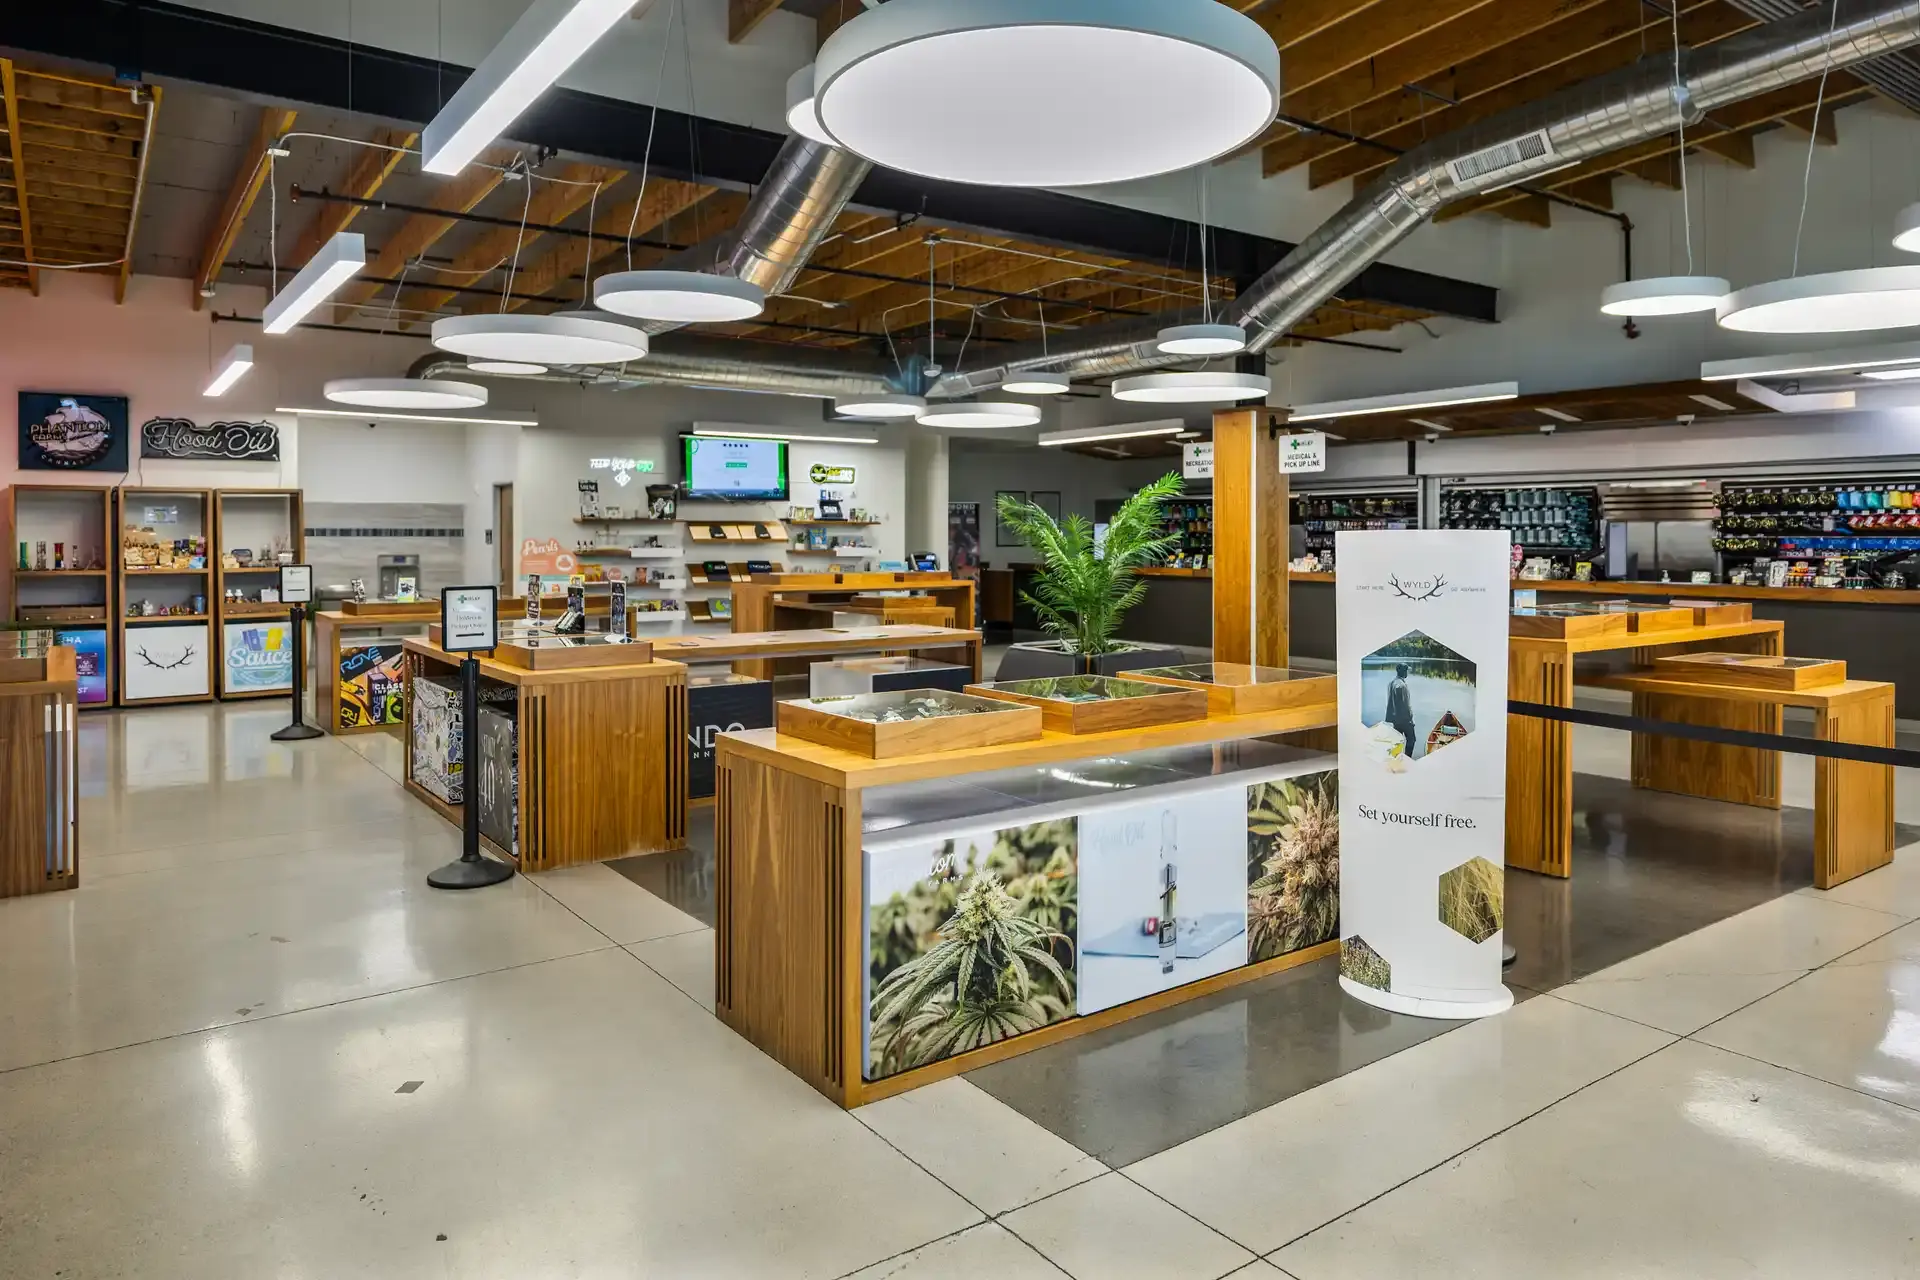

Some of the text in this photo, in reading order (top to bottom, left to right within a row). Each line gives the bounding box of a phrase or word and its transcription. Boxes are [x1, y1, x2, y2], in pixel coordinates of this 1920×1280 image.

[30, 420, 110, 435] PHANTOM
[151, 424, 268, 452] Hood Oil
[1287, 452, 1311, 460] MEDICAL
[1403, 581, 1431, 589] WYLD
[227, 647, 292, 668] Sauce
[340, 645, 381, 674] ROVE
[374, 683, 404, 691] CLASS
[1358, 804, 1477, 829] Set yourself free.
[927, 874, 964, 888] FARMS
